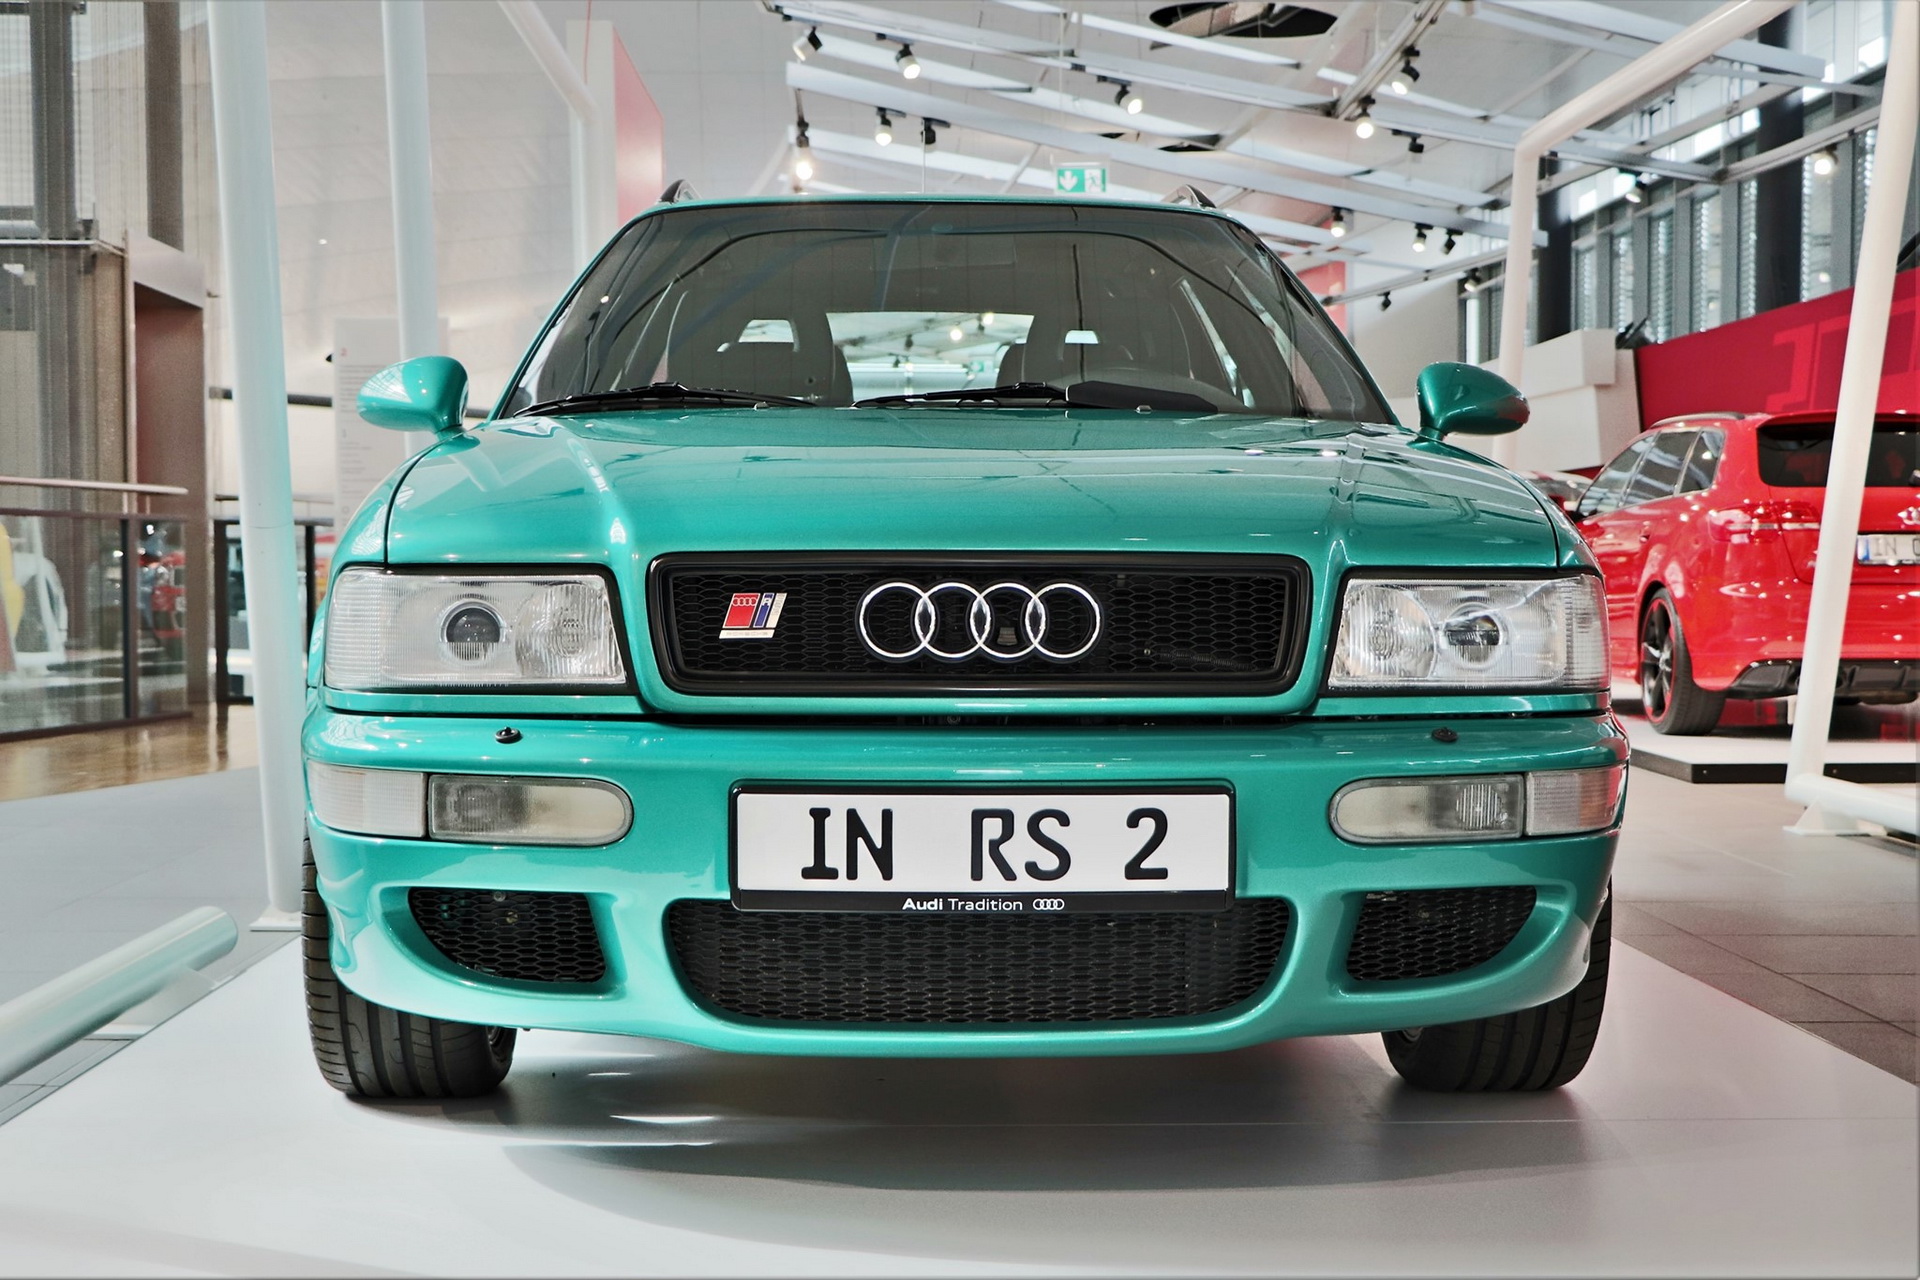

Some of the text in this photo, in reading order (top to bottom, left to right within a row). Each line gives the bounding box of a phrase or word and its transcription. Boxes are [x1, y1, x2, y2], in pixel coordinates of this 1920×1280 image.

[801, 807, 1168, 881] IN RS 2
[902, 897, 1023, 911] Audi Tradition
